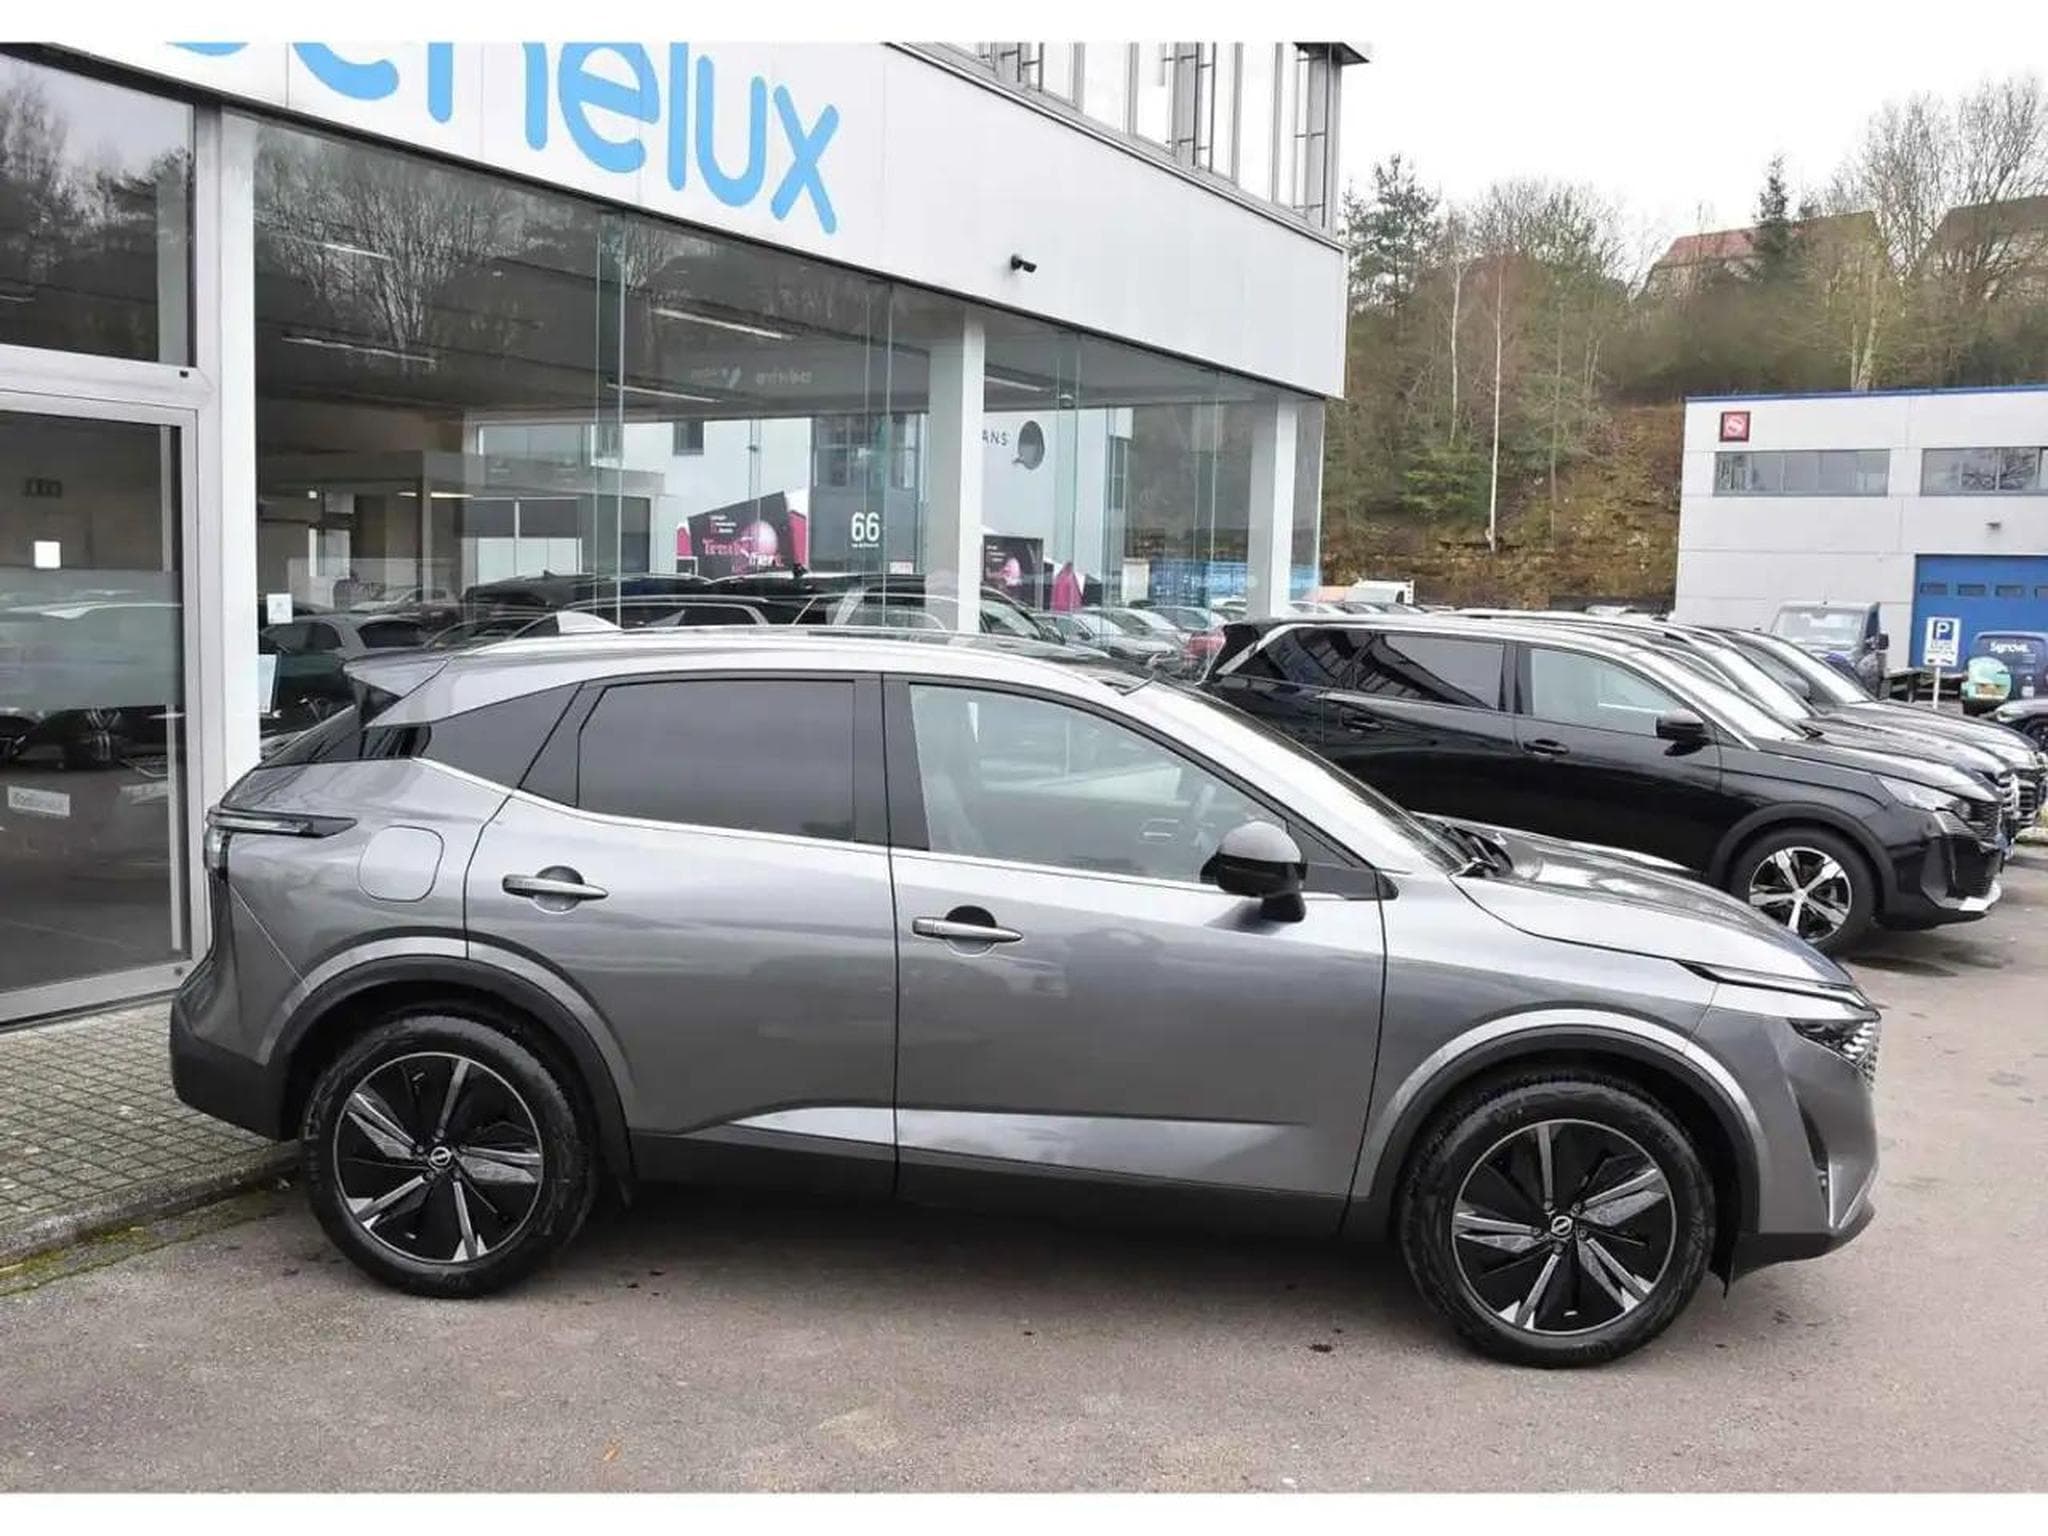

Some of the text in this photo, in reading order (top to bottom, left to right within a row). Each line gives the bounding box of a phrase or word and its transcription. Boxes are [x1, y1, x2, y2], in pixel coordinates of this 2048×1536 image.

[165, 42, 840, 235] nelux
[851, 511, 881, 543] 66
[1936, 621, 1951, 640] P
